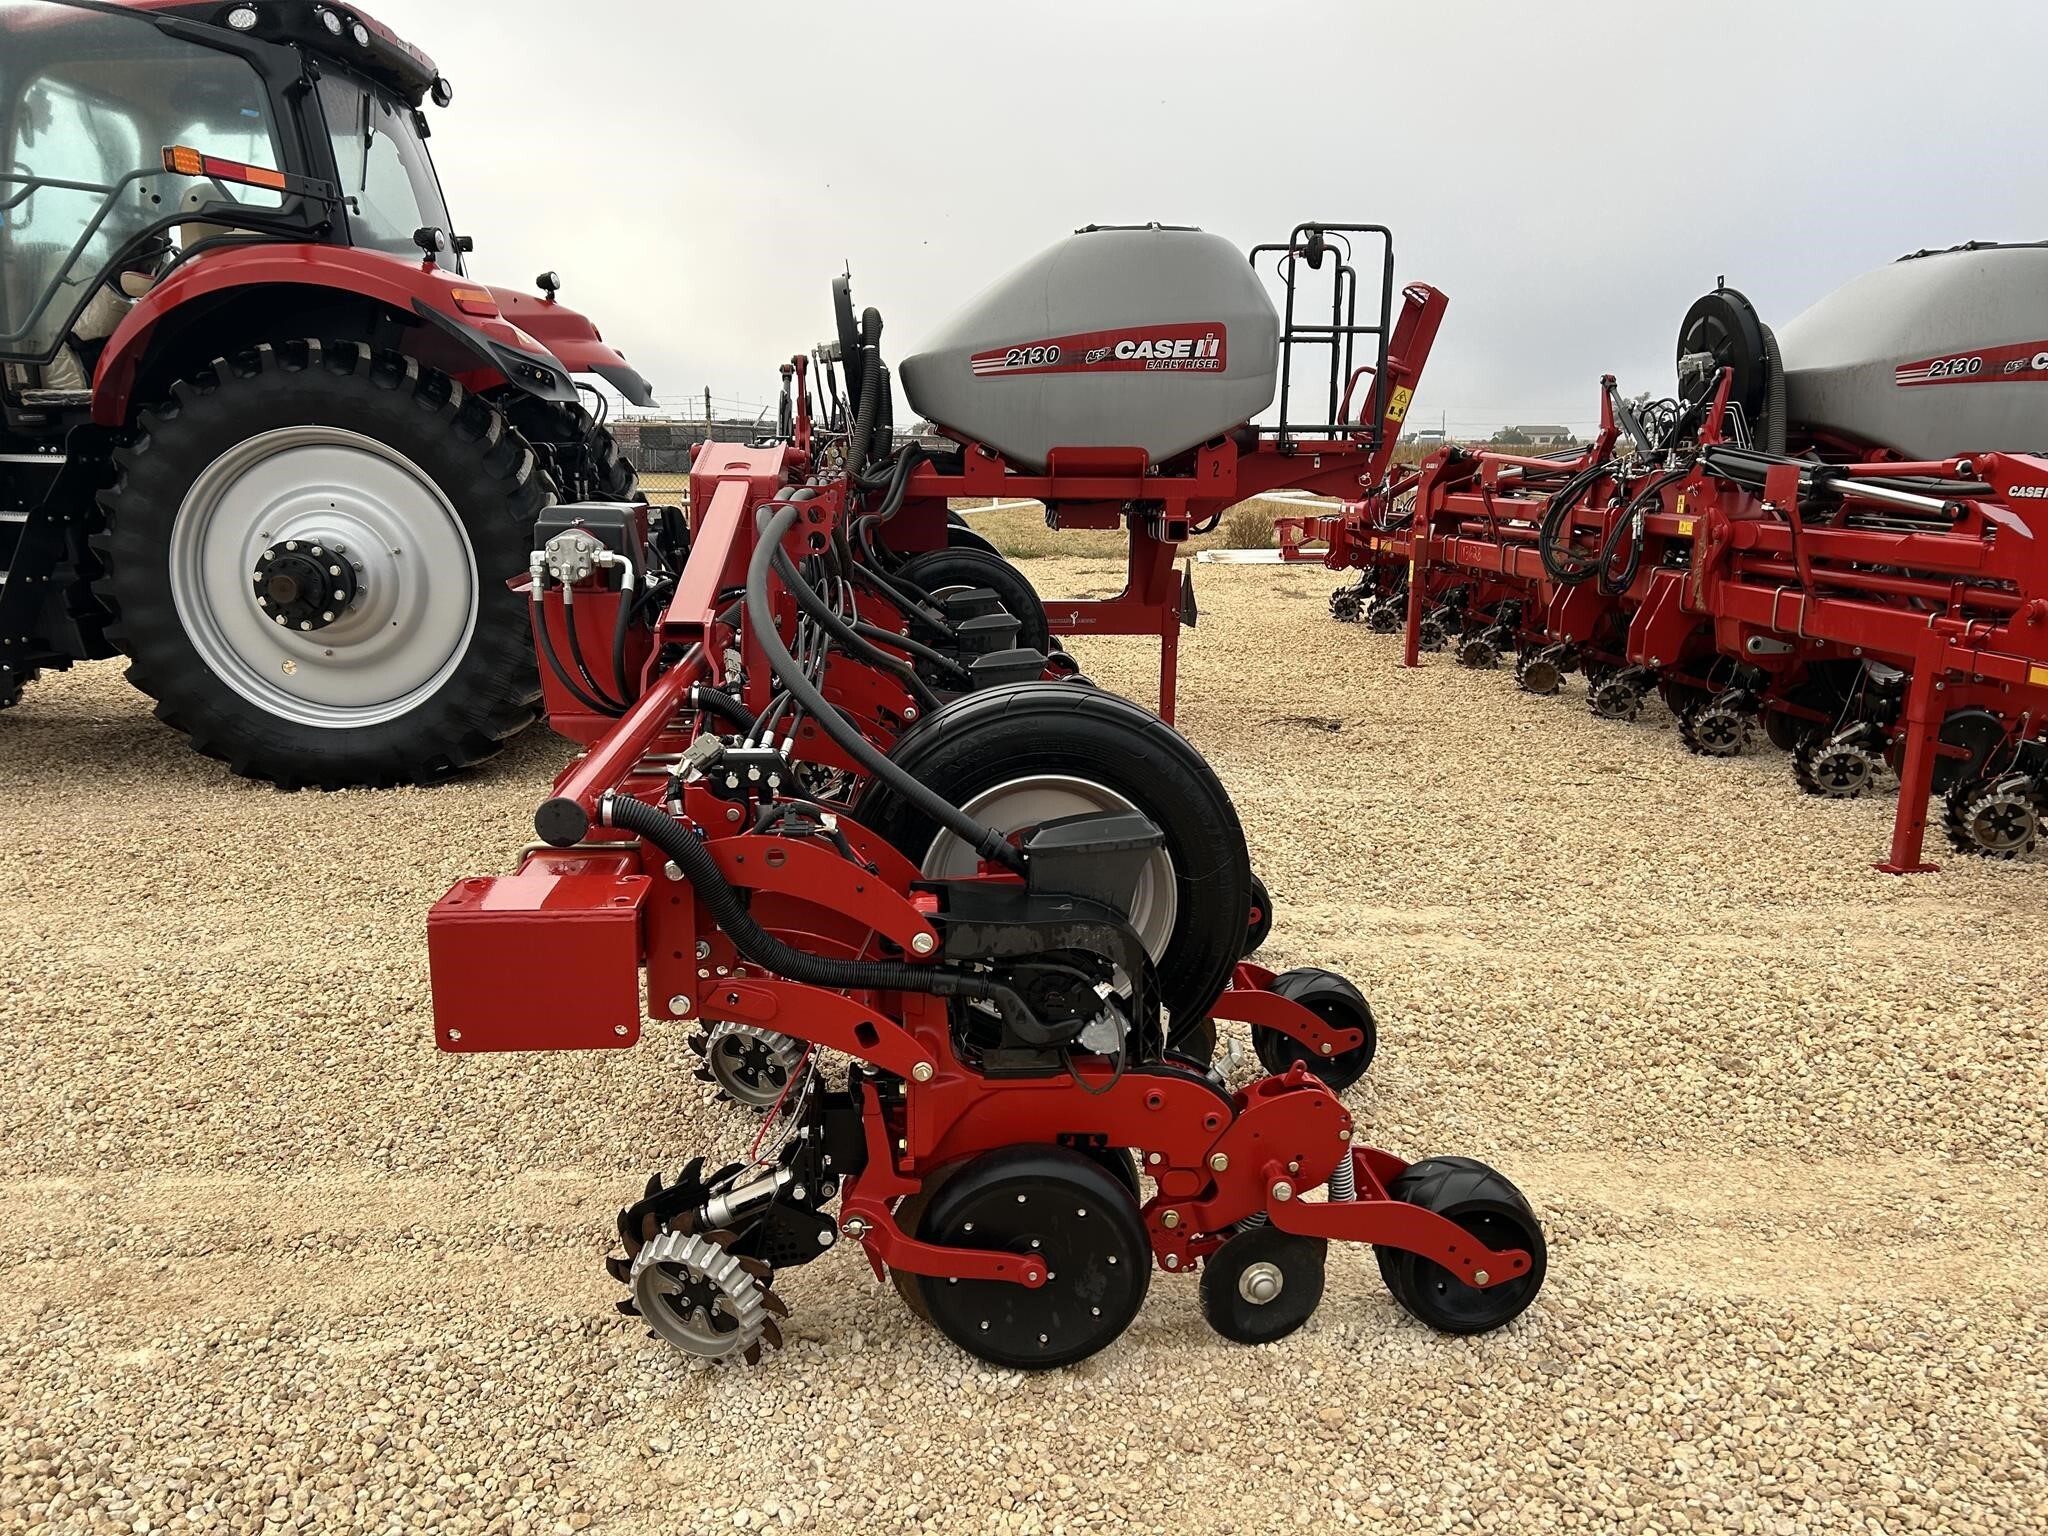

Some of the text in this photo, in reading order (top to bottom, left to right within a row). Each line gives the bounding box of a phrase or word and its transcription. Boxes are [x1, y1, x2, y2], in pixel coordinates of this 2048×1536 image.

[1004, 345, 1060, 367] 2130
[1115, 339, 1193, 360] CASE
[1145, 359, 1219, 370] EARLY RISER
[1928, 356, 1982, 377] 2130
[1212, 460, 1220, 478] 2
[2008, 485, 2044, 498] CASE
